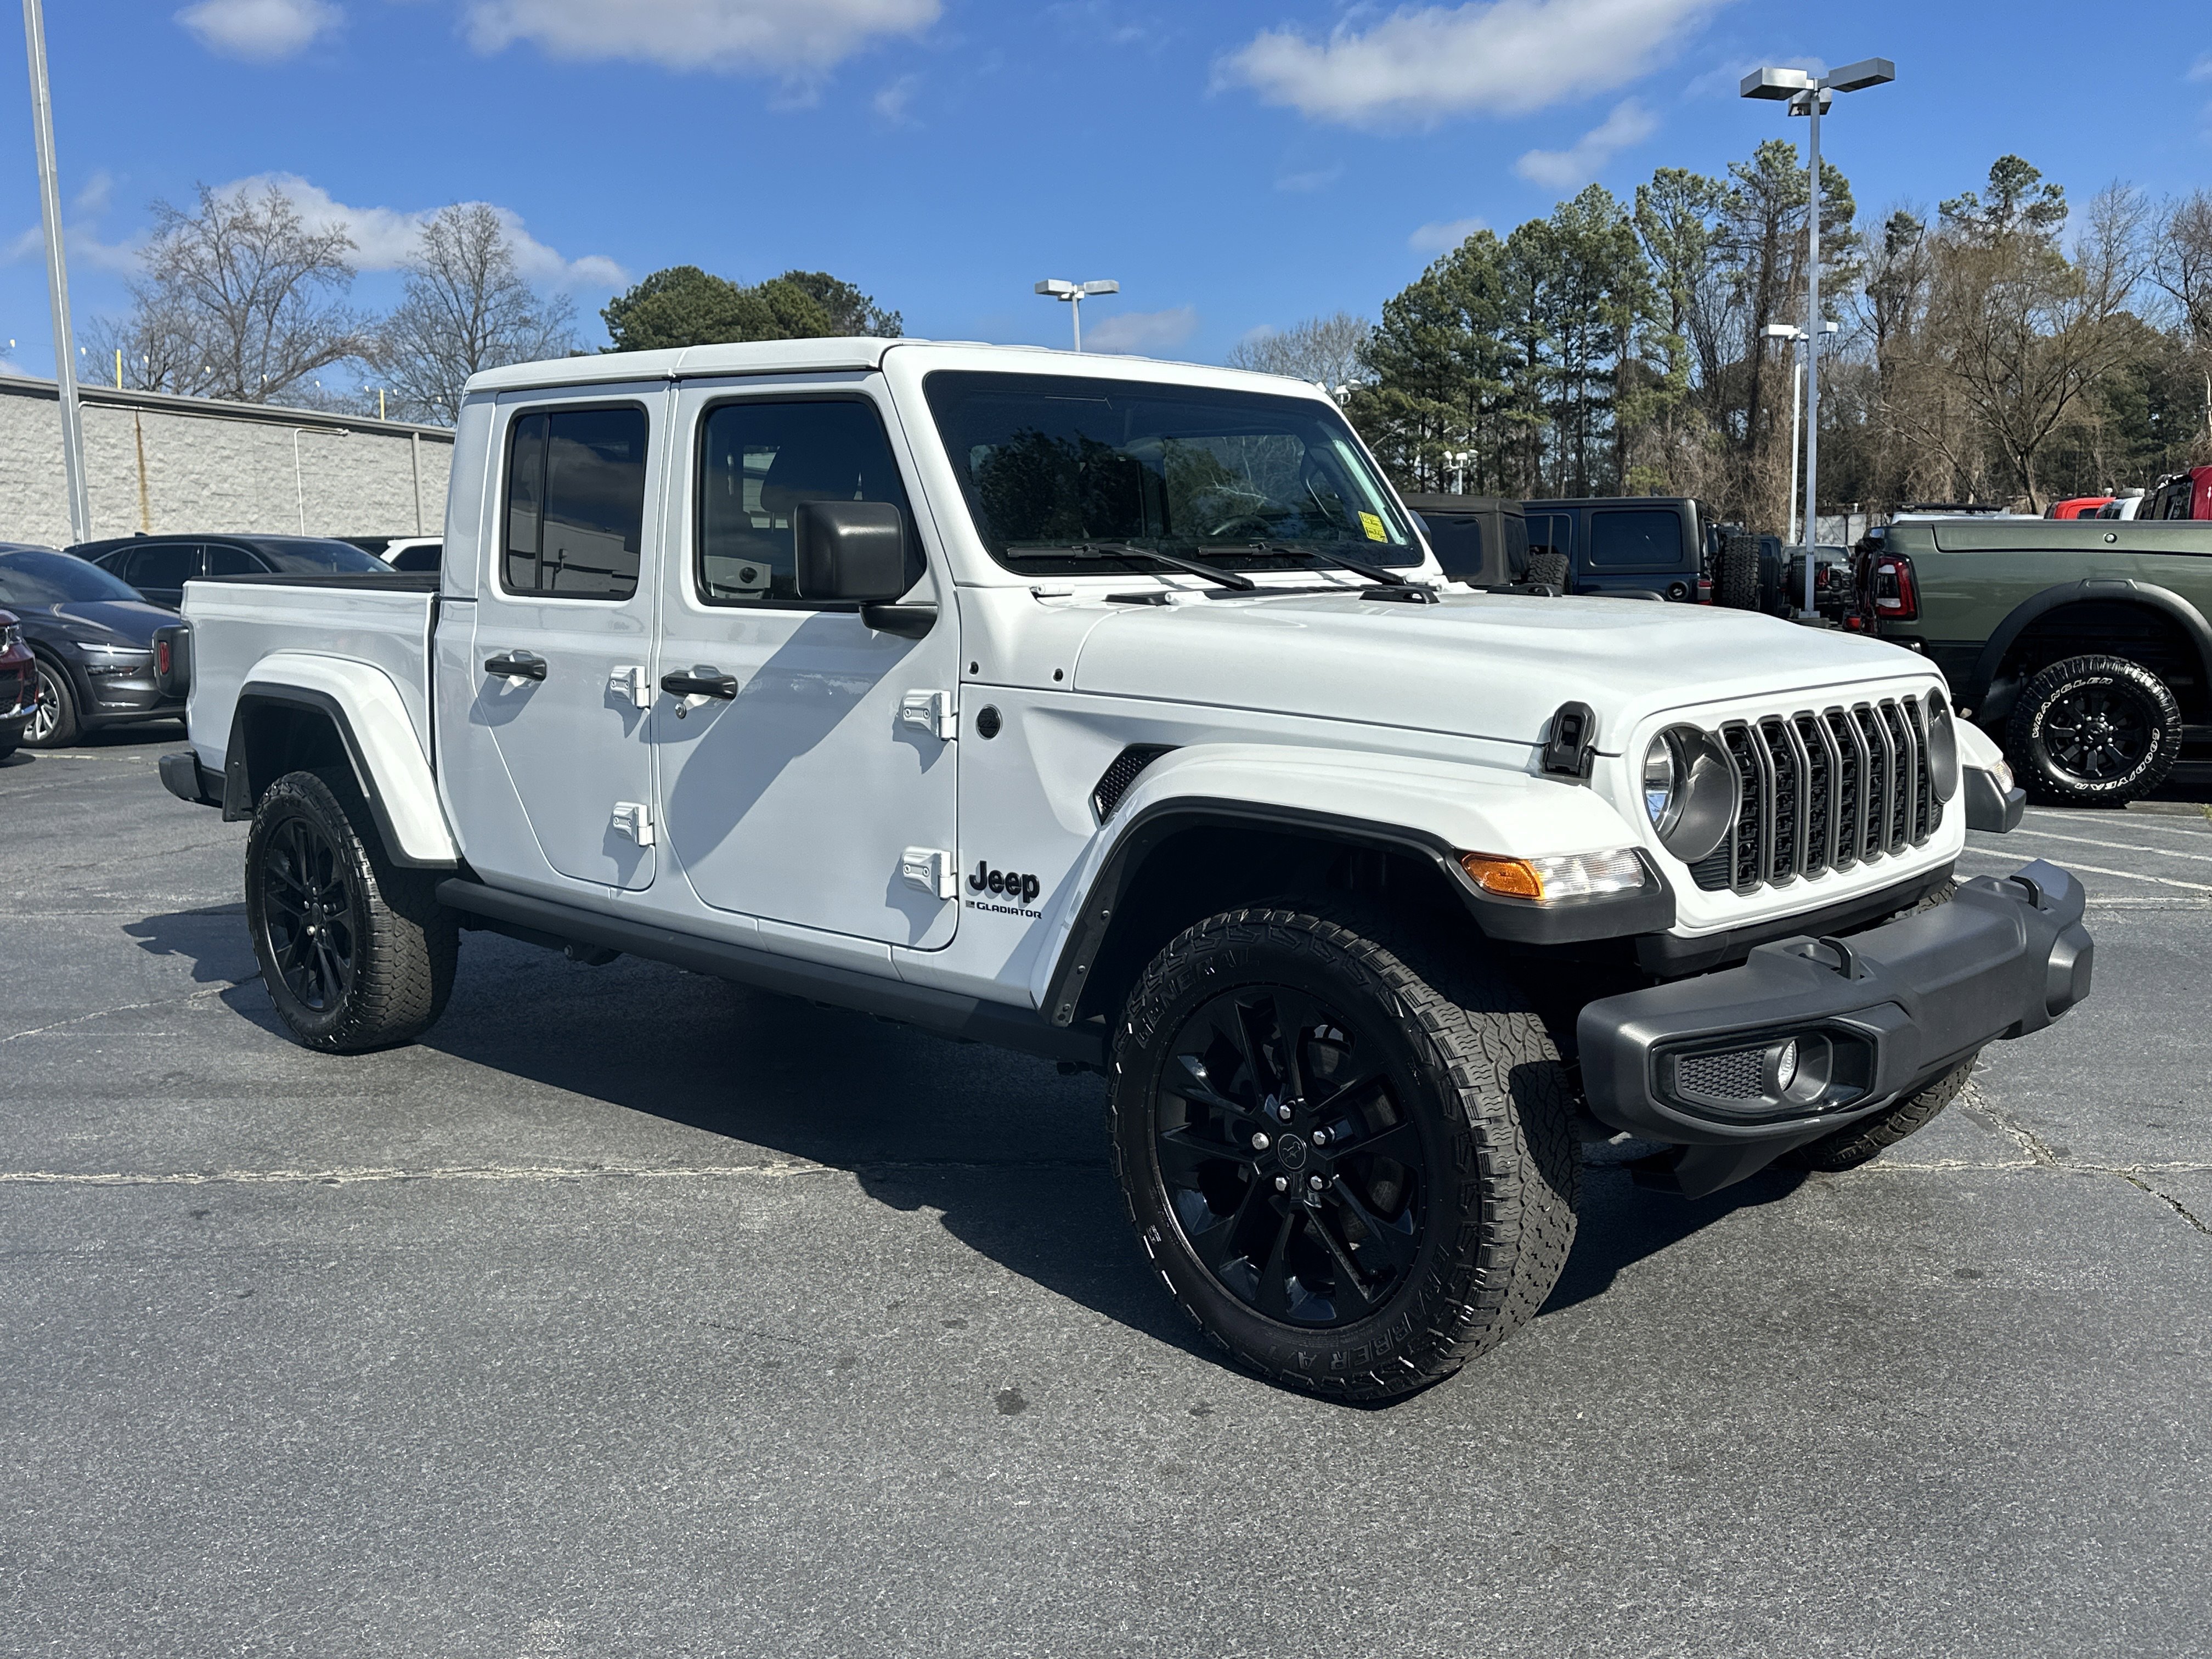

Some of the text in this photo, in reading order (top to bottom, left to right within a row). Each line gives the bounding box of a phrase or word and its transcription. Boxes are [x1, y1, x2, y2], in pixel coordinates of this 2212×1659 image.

[2032, 677, 2113, 738] WRANGLER
[2075, 727, 2160, 790] GOODYEAR
[969, 860, 1040, 904] Jeep
[976, 901, 1042, 919] GLADIATOR
